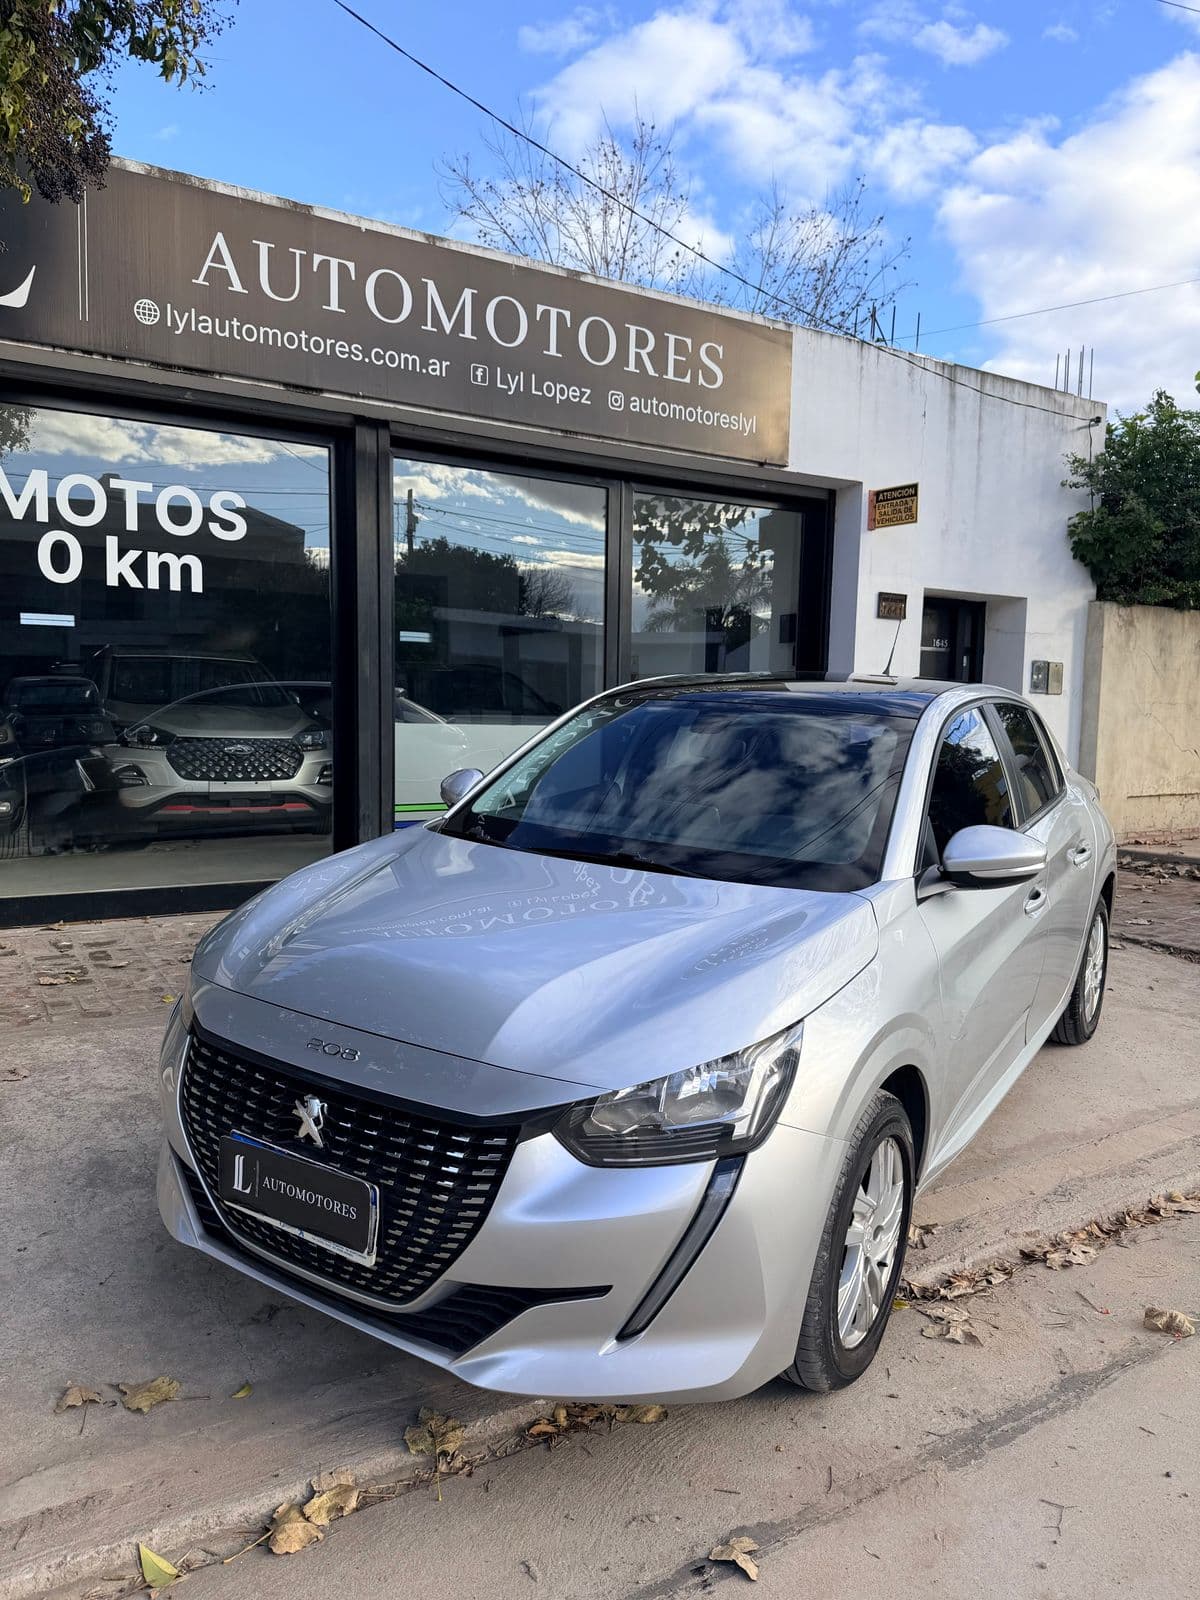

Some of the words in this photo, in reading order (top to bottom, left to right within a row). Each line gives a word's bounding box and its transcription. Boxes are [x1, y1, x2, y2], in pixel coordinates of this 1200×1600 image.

[191, 231, 725, 391] AUTOMOTORES
[165, 303, 451, 378] lylautomotores.com.ar
[496, 366, 524, 396] Lyl
[531, 373, 592, 405] Lopez
[629, 393, 757, 436] automotoreslyl
[0, 467, 248, 541] MOTOS
[877, 499, 909, 510] ENTRADA
[878, 487, 915, 501] ATENCION
[878, 507, 903, 517] SALIDA
[903, 505, 912, 514] DE
[877, 512, 915, 525] VEHICULOS
[37, 530, 83, 584] 0
[106, 535, 204, 593] km
[306, 1038, 361, 1061] 208
[262, 1175, 358, 1221] AUTOMOTORES
